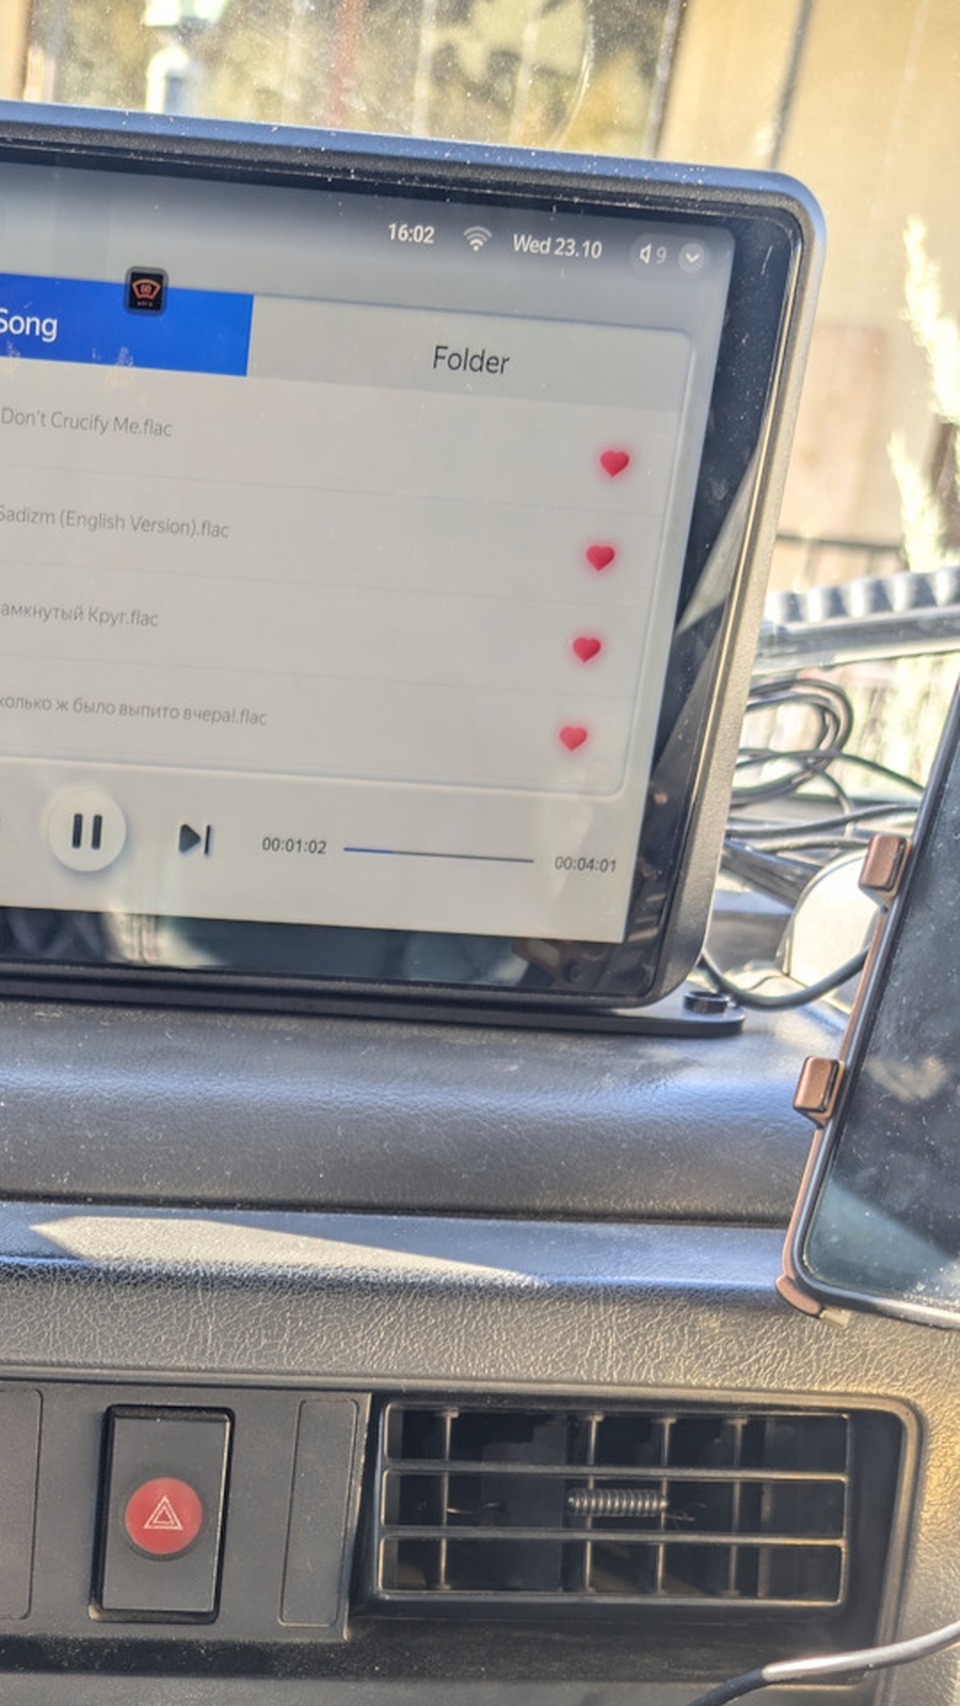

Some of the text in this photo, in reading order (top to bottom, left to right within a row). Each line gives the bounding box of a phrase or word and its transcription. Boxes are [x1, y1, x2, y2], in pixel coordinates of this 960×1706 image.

[388, 221, 435, 246] 16:02
[513, 233, 603, 260] Wed 23.10
[432, 344, 511, 376] Folder
[1, 406, 46, 427] Don't
[51, 411, 109, 436] Crucify
[113, 416, 173, 437] Me.flac
[60, 509, 125, 533] (English
[129, 514, 230, 539] Version).flac
[88, 605, 159, 628] Круг.flac
[56, 700, 68, 712] ж
[72, 696, 116, 716] было
[119, 703, 180, 720] выпито
[261, 834, 327, 856] 00:01:02
[554, 854, 618, 874] 00:04:01
